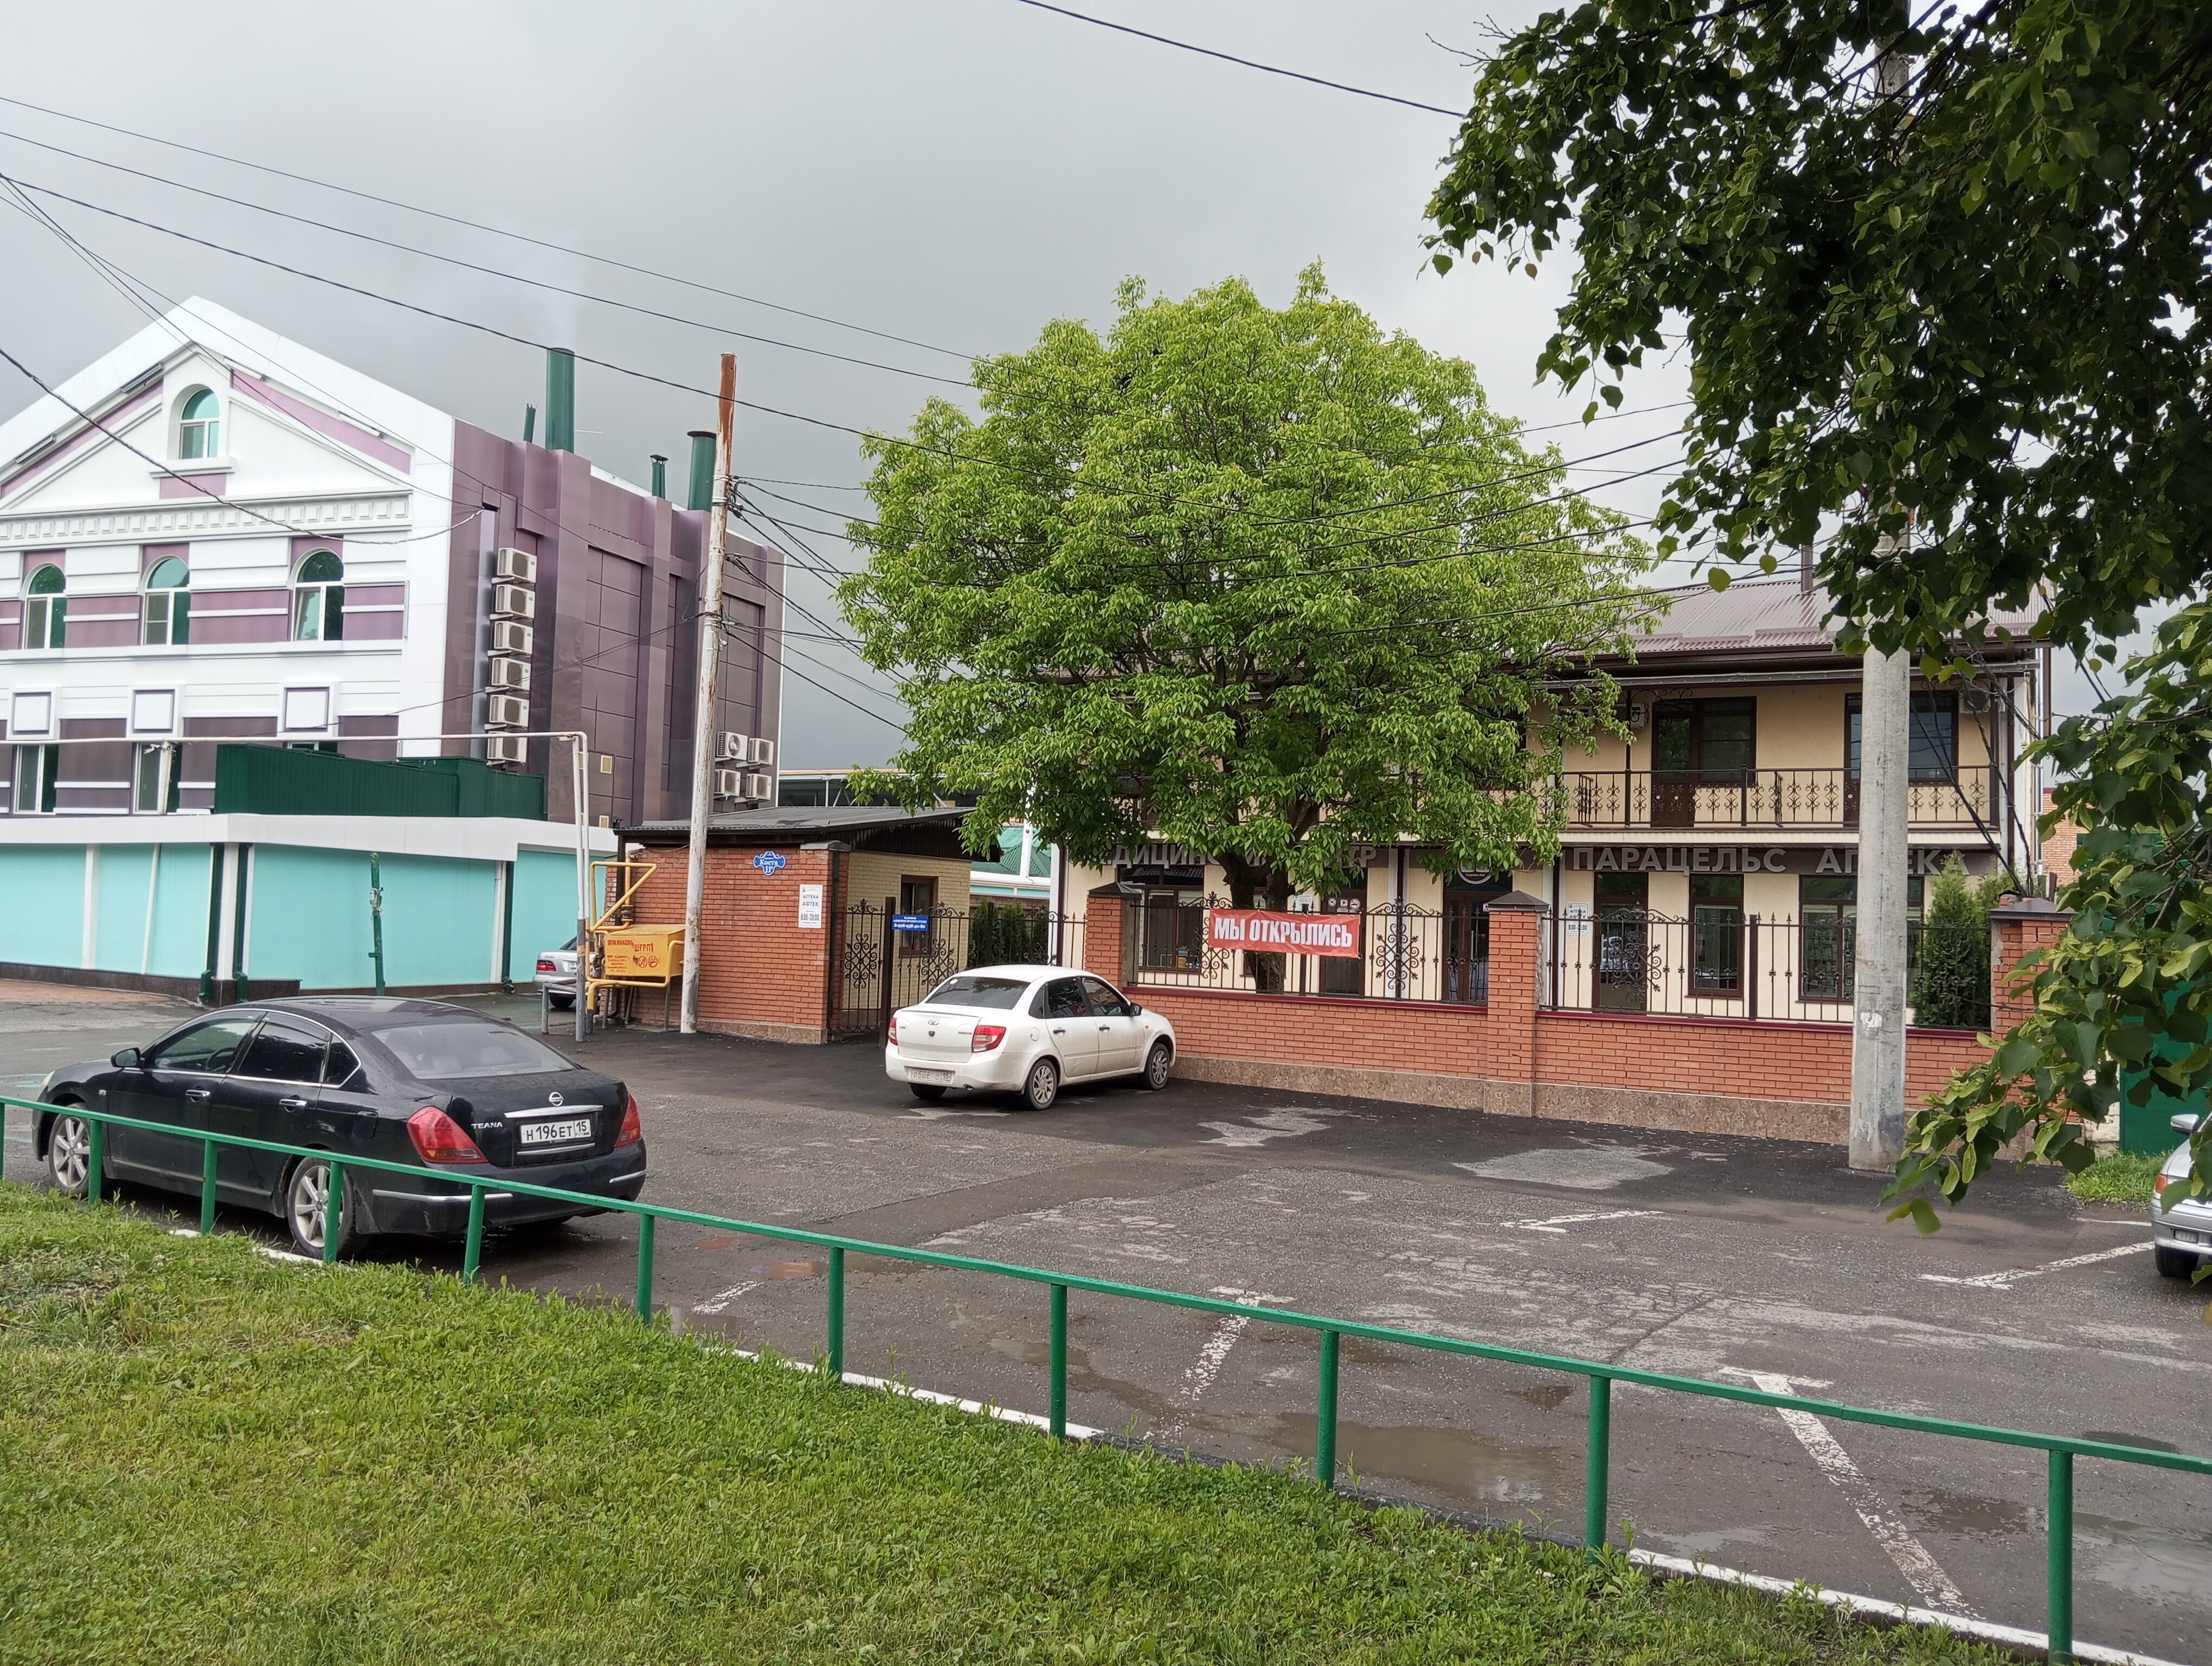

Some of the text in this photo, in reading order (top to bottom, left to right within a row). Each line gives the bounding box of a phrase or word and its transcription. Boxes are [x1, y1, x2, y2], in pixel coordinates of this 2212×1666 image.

[1573, 847, 1787, 876] ПАРАЦЕЛЬС
[1214, 917, 1353, 947] МЫ ОТКРЫЛИСЬ
